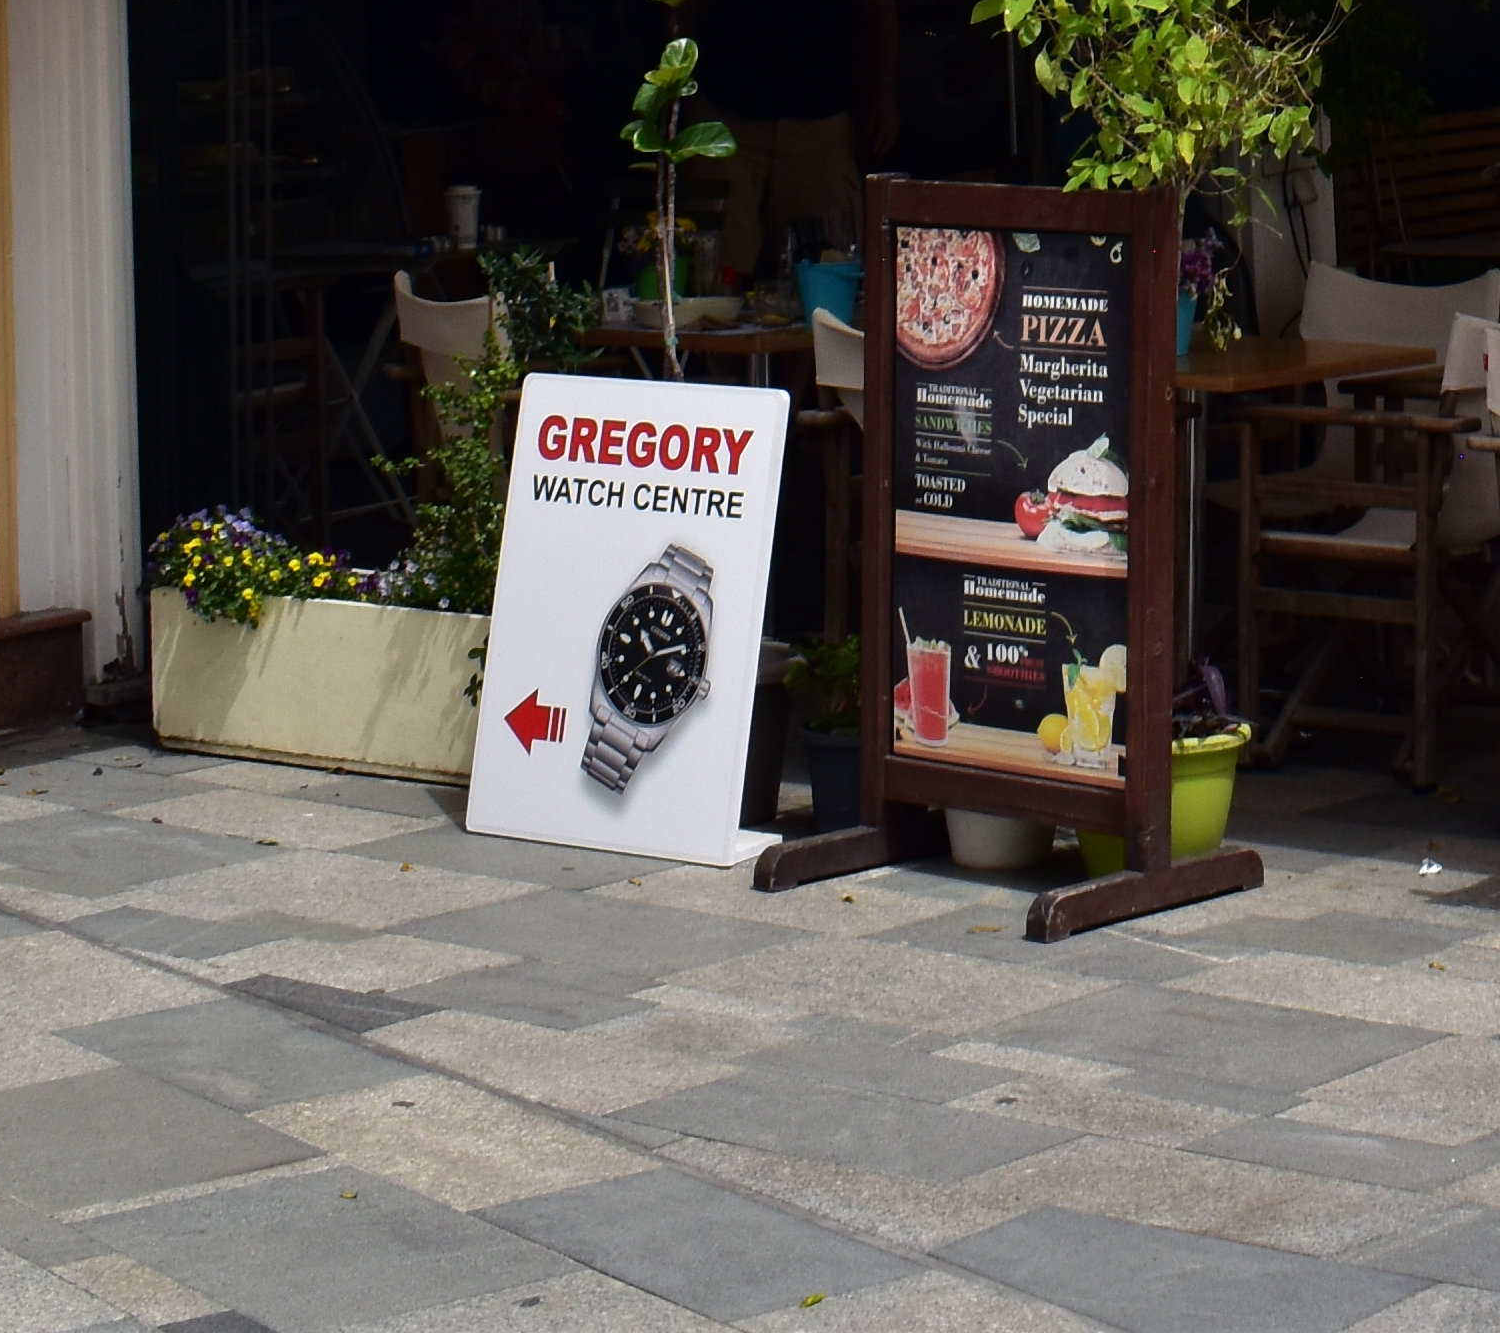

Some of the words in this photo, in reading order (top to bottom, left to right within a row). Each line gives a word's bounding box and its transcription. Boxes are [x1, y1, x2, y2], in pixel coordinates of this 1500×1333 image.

[1022, 294, 1108, 312] HOMEMADE
[1020, 314, 1107, 347] PIZZA
[1019, 354, 1108, 380] Margherita
[917, 387, 992, 408] Homemade
[928, 383, 978, 396] TRADITIONAL
[1019, 378, 1103, 404] Vegetarian
[915, 414, 992, 435] SANDWIHES
[1018, 403, 1073, 429] Special
[538, 414, 754, 475] GREGORY
[915, 473, 966, 493] TOASTED
[533, 474, 625, 510] WATCH
[633, 483, 745, 519] CENTRE
[923, 492, 953, 509] COLD
[963, 579, 1046, 604] Homemade
[977, 576, 1031, 591] TRADITIONAL
[963, 609, 1046, 636] LEMONADE
[964, 645, 981, 668] &
[987, 642, 1029, 665] 100%
